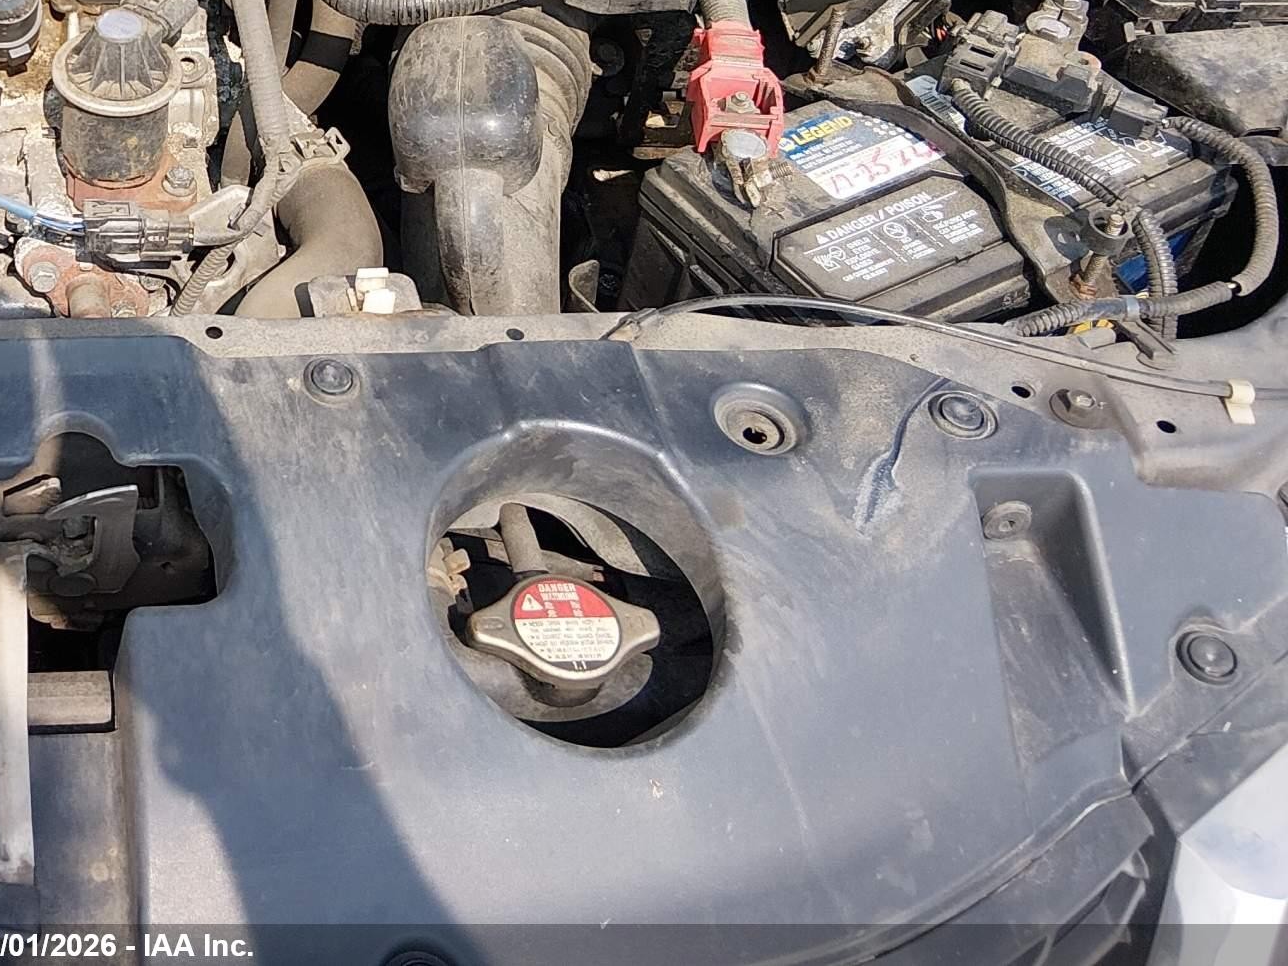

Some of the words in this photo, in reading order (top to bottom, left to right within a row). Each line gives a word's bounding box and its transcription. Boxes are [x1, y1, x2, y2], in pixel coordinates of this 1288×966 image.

[791, 116, 854, 146] LEGEND
[825, 212, 880, 240] DANGER
[886, 191, 933, 216] POISON
[538, 582, 577, 593] DANGER
[572, 660, 587, 671] 1.1
